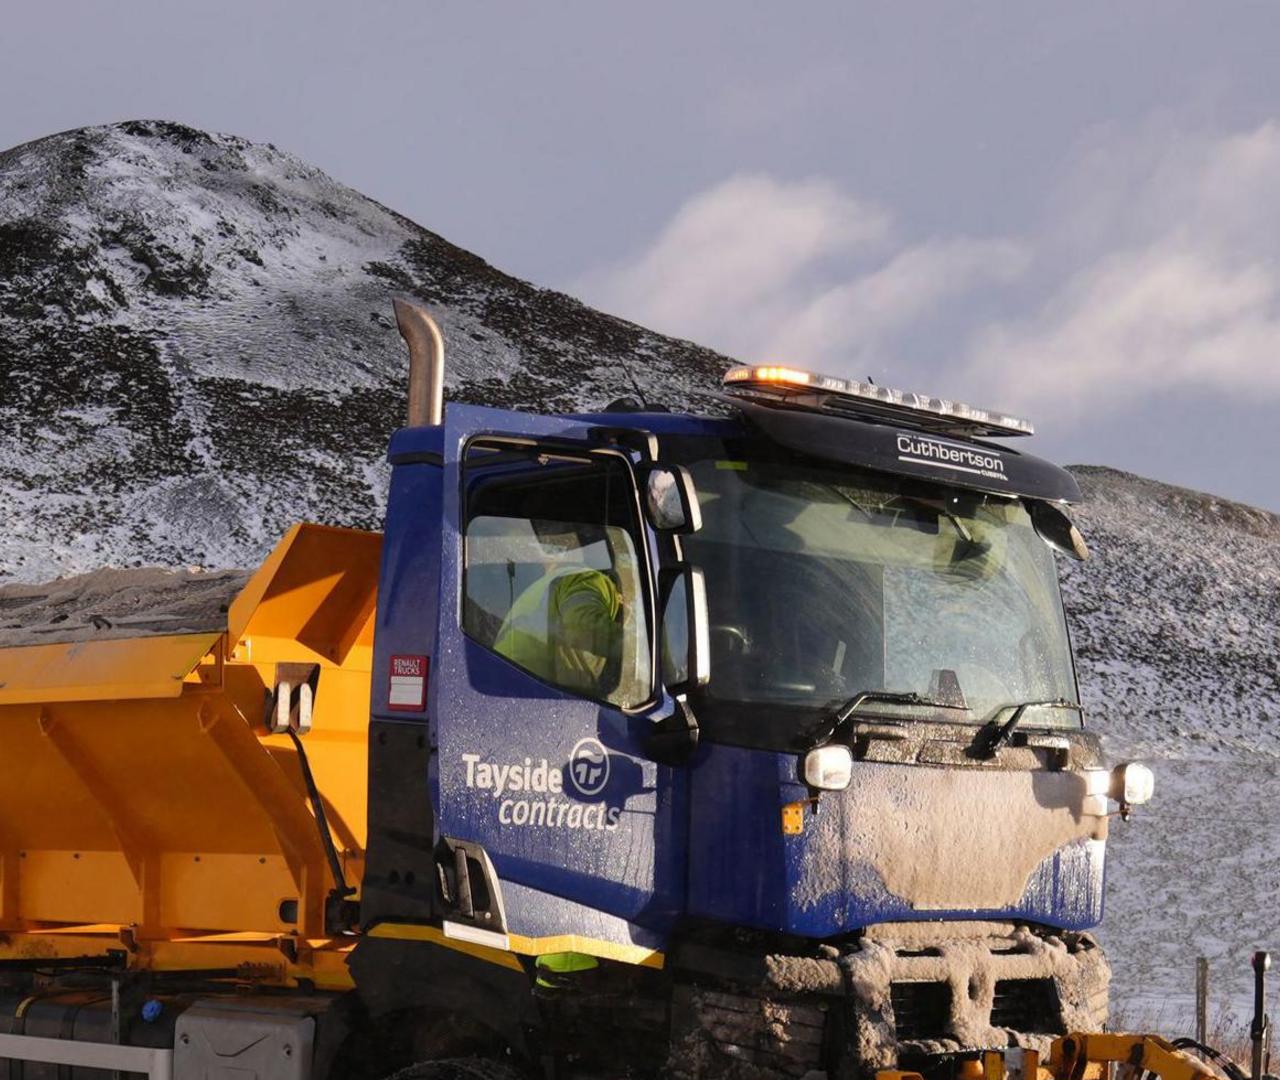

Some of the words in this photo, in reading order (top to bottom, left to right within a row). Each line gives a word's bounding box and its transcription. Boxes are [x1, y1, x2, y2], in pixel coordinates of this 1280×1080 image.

[897, 437, 1004, 472] Cuthbertson
[462, 753, 563, 798] Tayside
[498, 798, 620, 830] contracts
